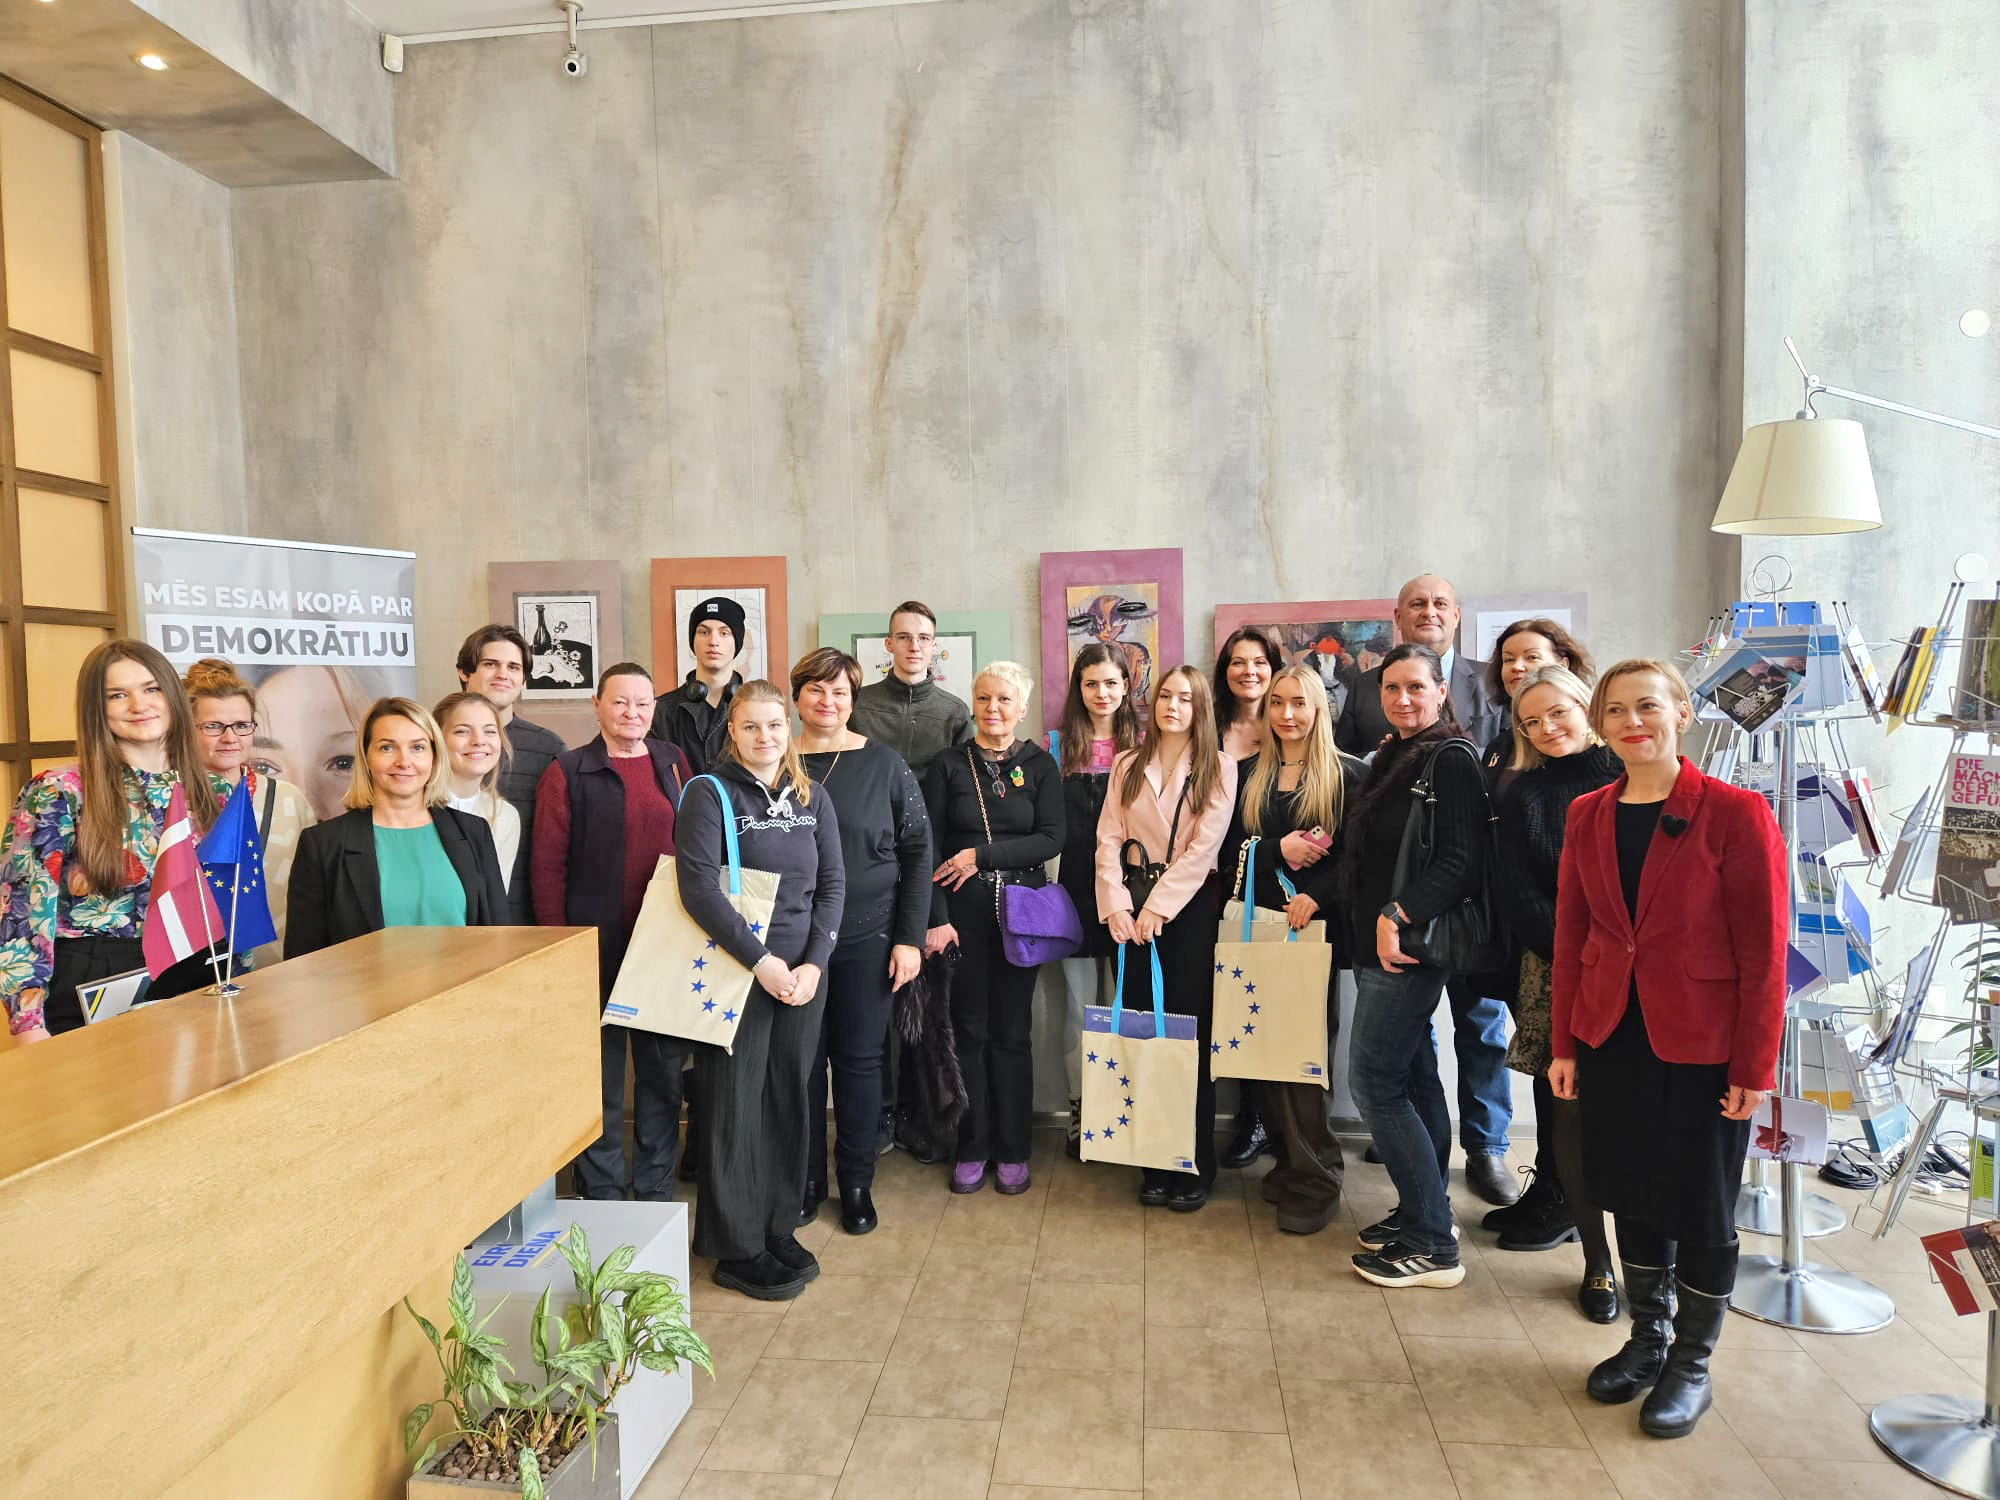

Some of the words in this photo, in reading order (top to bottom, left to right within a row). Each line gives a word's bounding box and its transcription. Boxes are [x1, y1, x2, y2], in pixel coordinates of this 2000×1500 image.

[143, 579, 208, 607] MĒS
[215, 586, 289, 612] ESAM
[296, 590, 365, 615] KOPĀ
[370, 595, 413, 617] PAR
[161, 624, 409, 657] DEMOKRĀTIJU
[1956, 757, 1984, 770] DIE
[1953, 780, 1988, 796] DER
[734, 815, 817, 835] Champion
[502, 1230, 562, 1267] DIENA
